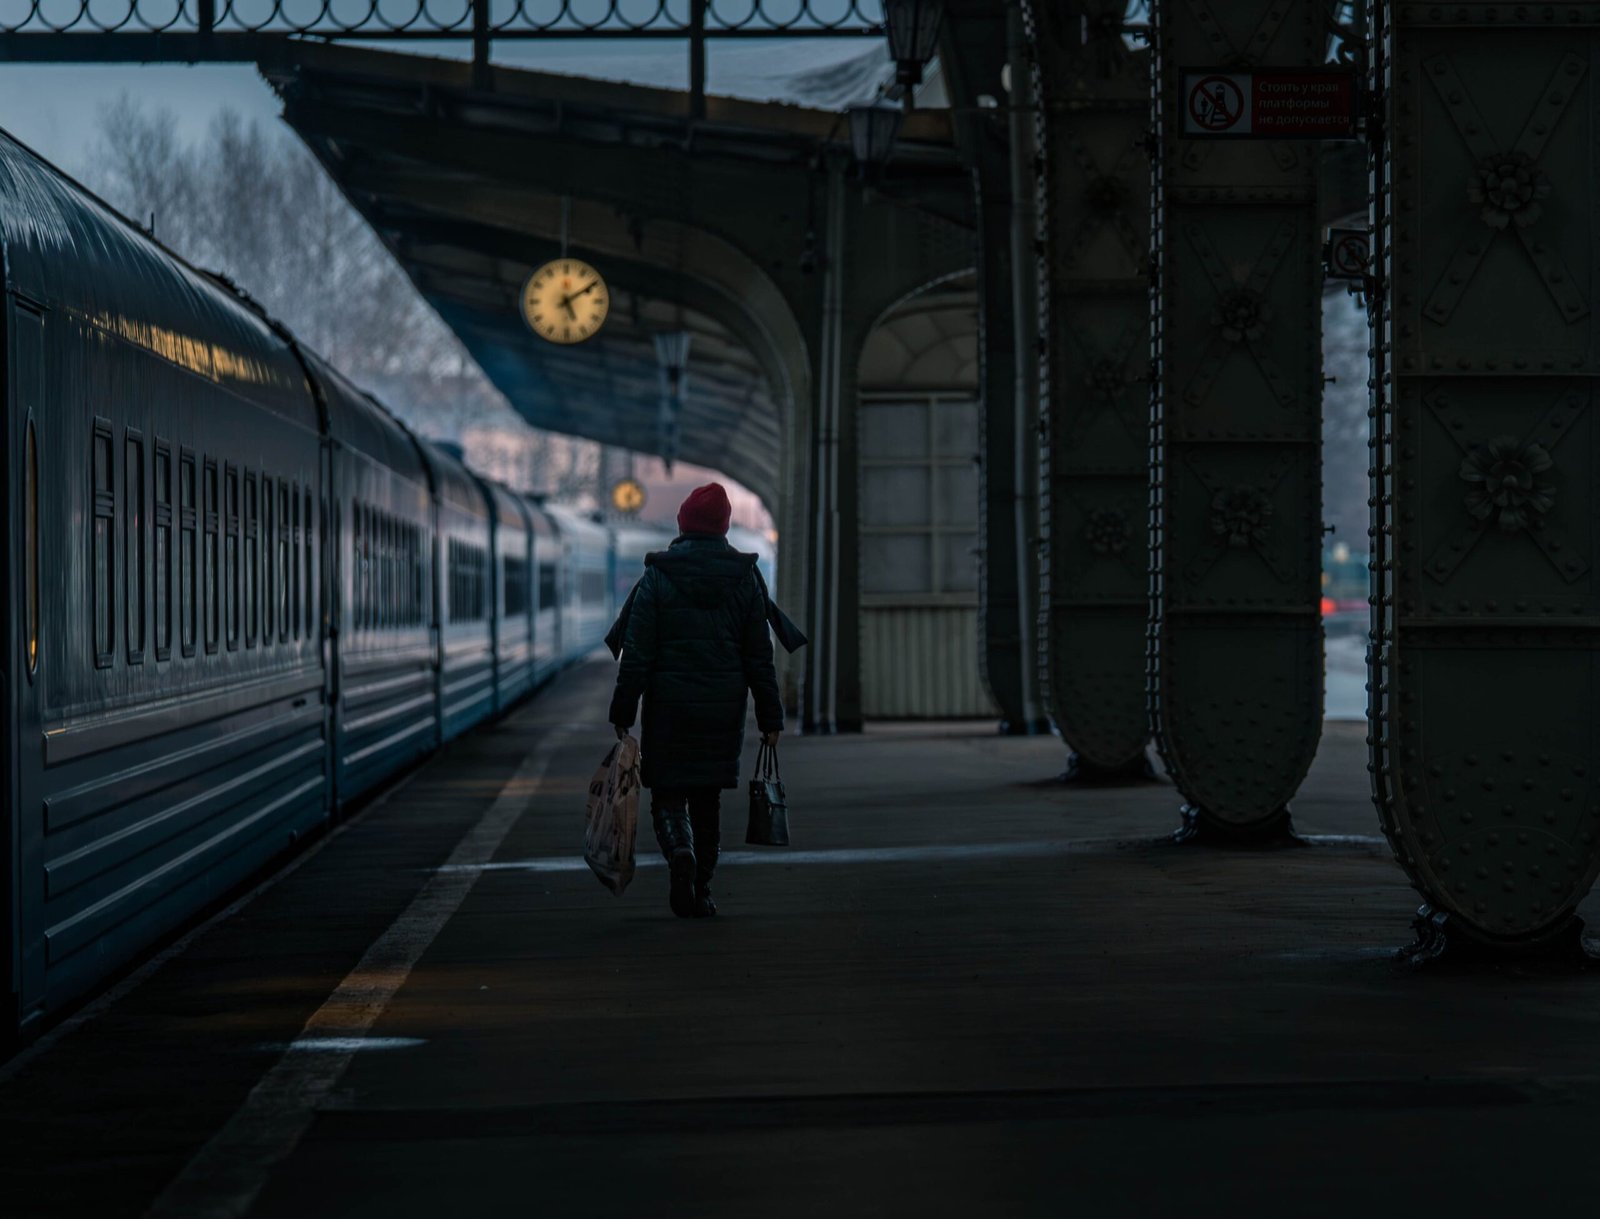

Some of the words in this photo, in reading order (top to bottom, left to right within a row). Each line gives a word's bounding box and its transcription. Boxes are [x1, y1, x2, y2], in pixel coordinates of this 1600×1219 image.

[1259, 81, 1299, 92] Стоять
[1302, 84, 1308, 95] у
[1310, 84, 1338, 95] края
[1259, 98, 1329, 110] платформы
[1259, 116, 1273, 124] не
[1276, 116, 1349, 127] допускается
